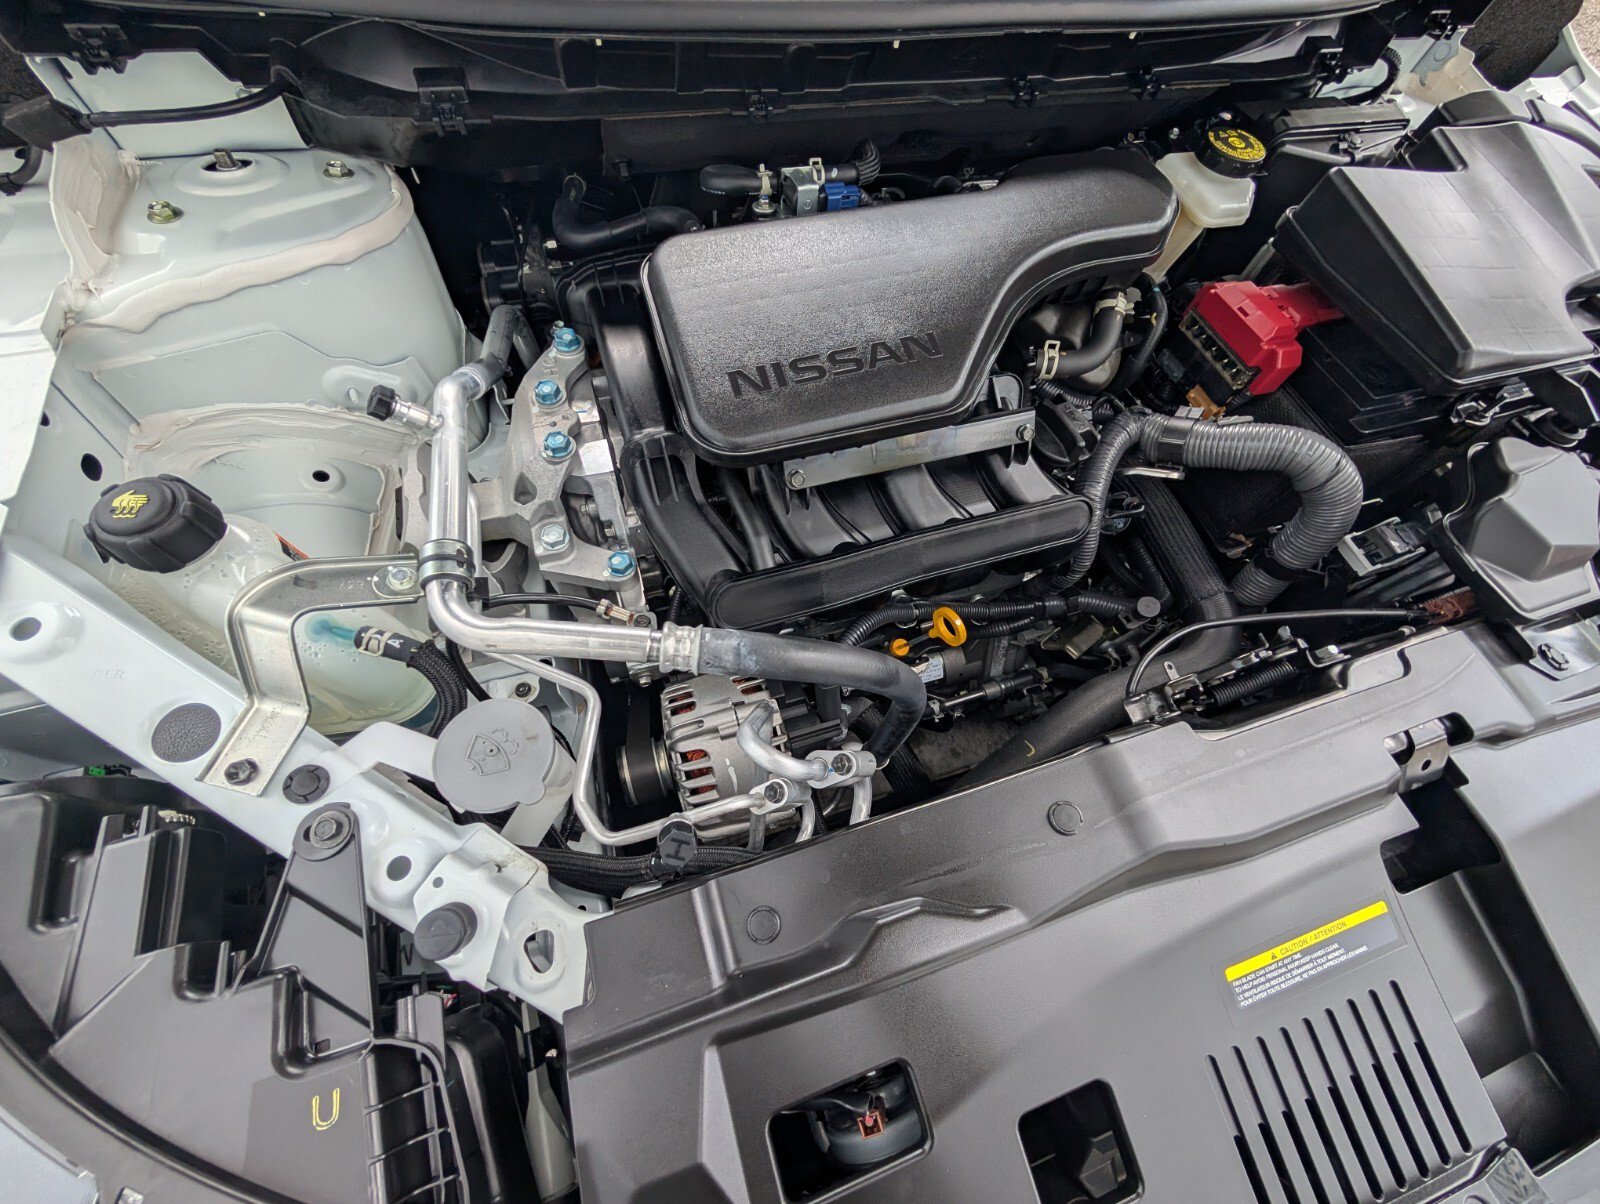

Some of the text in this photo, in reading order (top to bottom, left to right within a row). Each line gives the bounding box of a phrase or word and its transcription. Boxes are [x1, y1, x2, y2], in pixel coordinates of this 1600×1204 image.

[726, 331, 944, 400] NISSAN
[1280, 937, 1308, 956] CAUTION
[1314, 921, 1347, 941] ATTENTION
[1241, 981, 1253, 990] HELP
[312, 1087, 340, 1131] U
